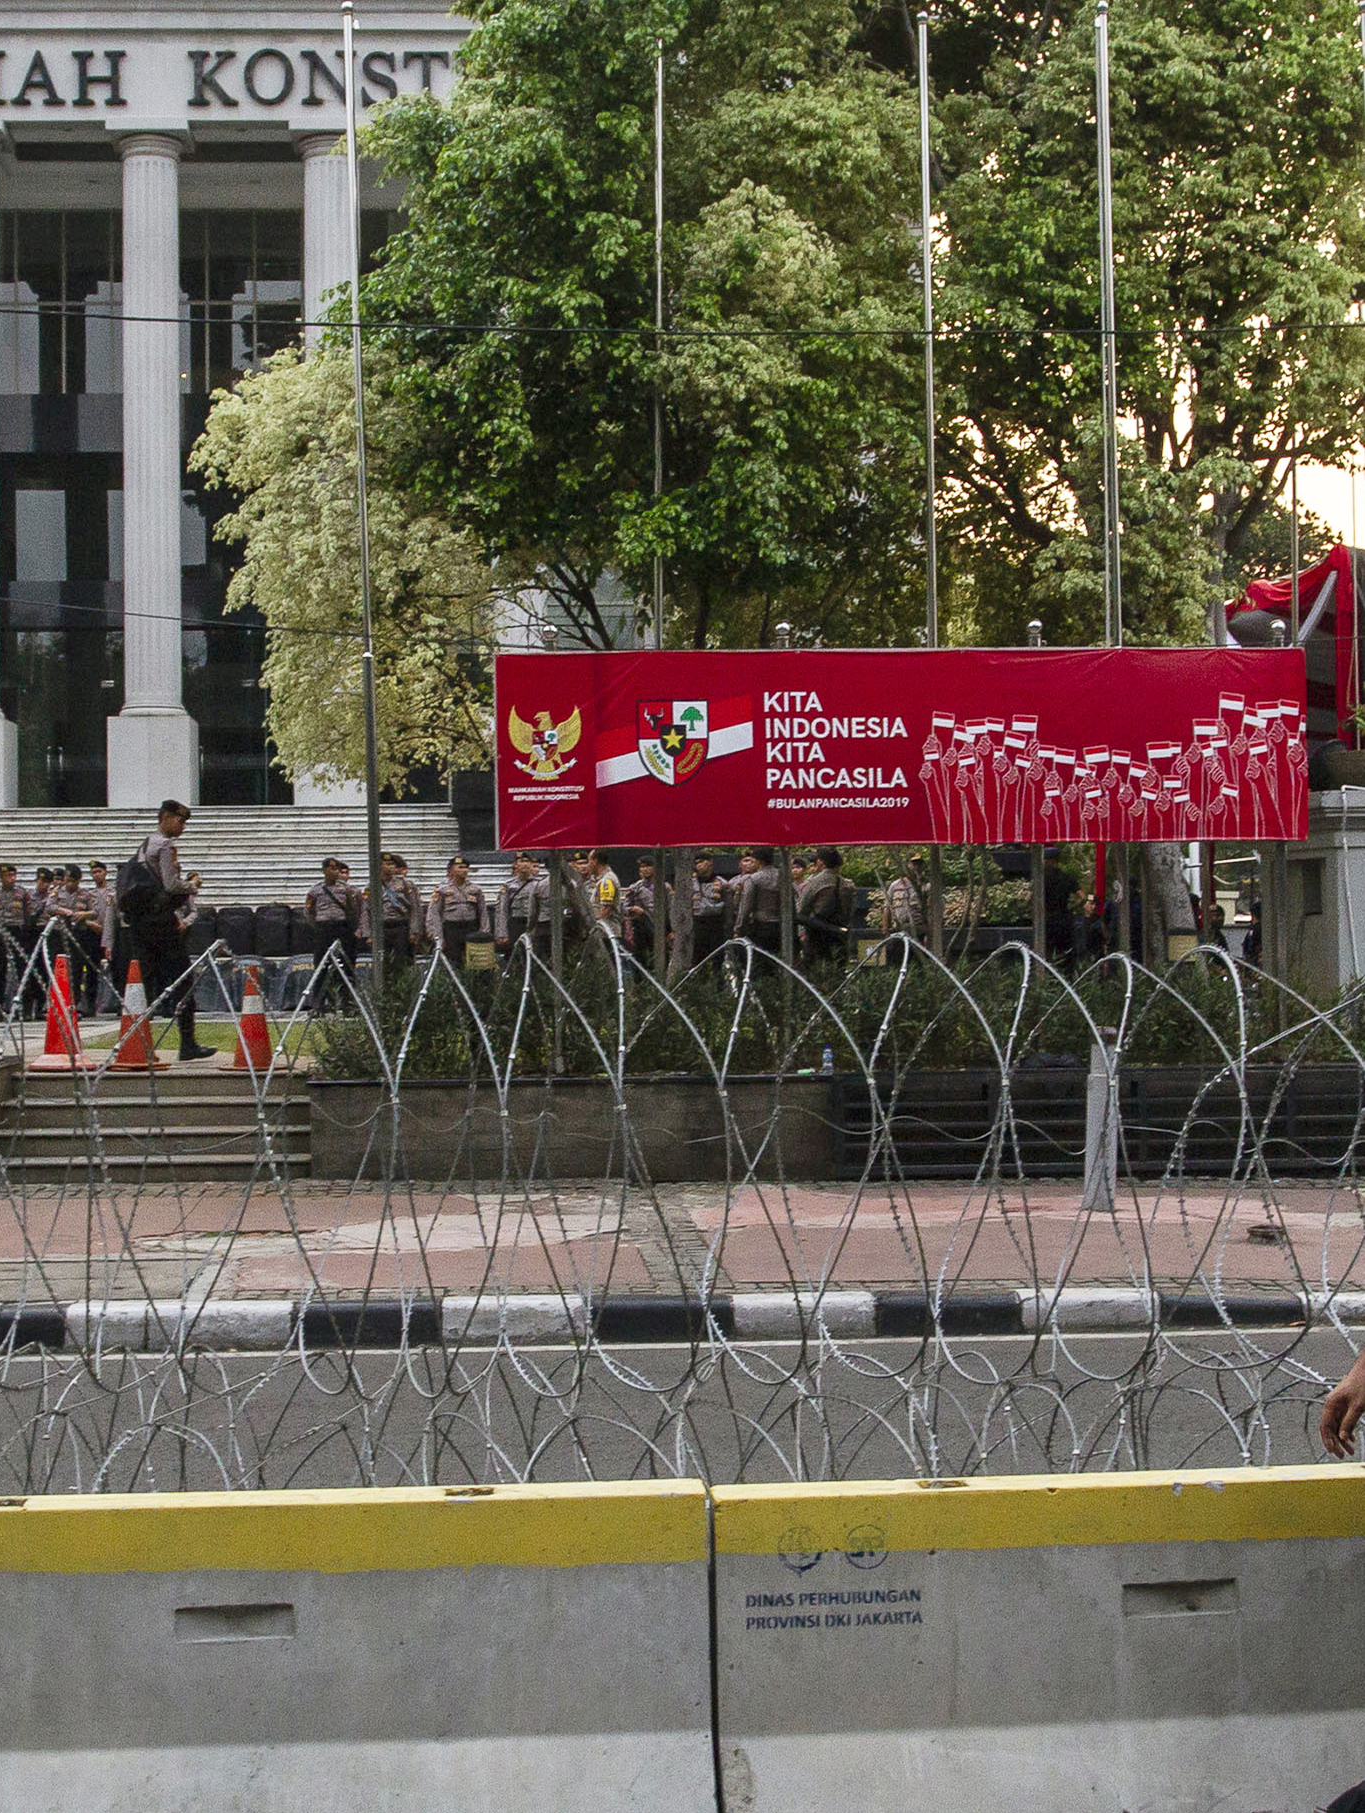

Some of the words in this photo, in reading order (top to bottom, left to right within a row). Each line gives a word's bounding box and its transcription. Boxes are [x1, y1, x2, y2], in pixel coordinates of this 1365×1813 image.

[186, 48, 461, 108] KONST
[763, 691, 823, 713] KITA
[764, 717, 909, 739] INDONESIA
[766, 741, 826, 763] KITA
[765, 767, 909, 790] PANCASILA
[767, 796, 910, 809] #BULANPANCASILA2019
[745, 1593, 795, 1608] DINAS
[798, 1589, 922, 1606] PERHUBUNGAN
[745, 1614, 821, 1630] PROVINSI
[824, 1613, 852, 1628] DKI
[855, 1611, 923, 1627] JAKARTA
